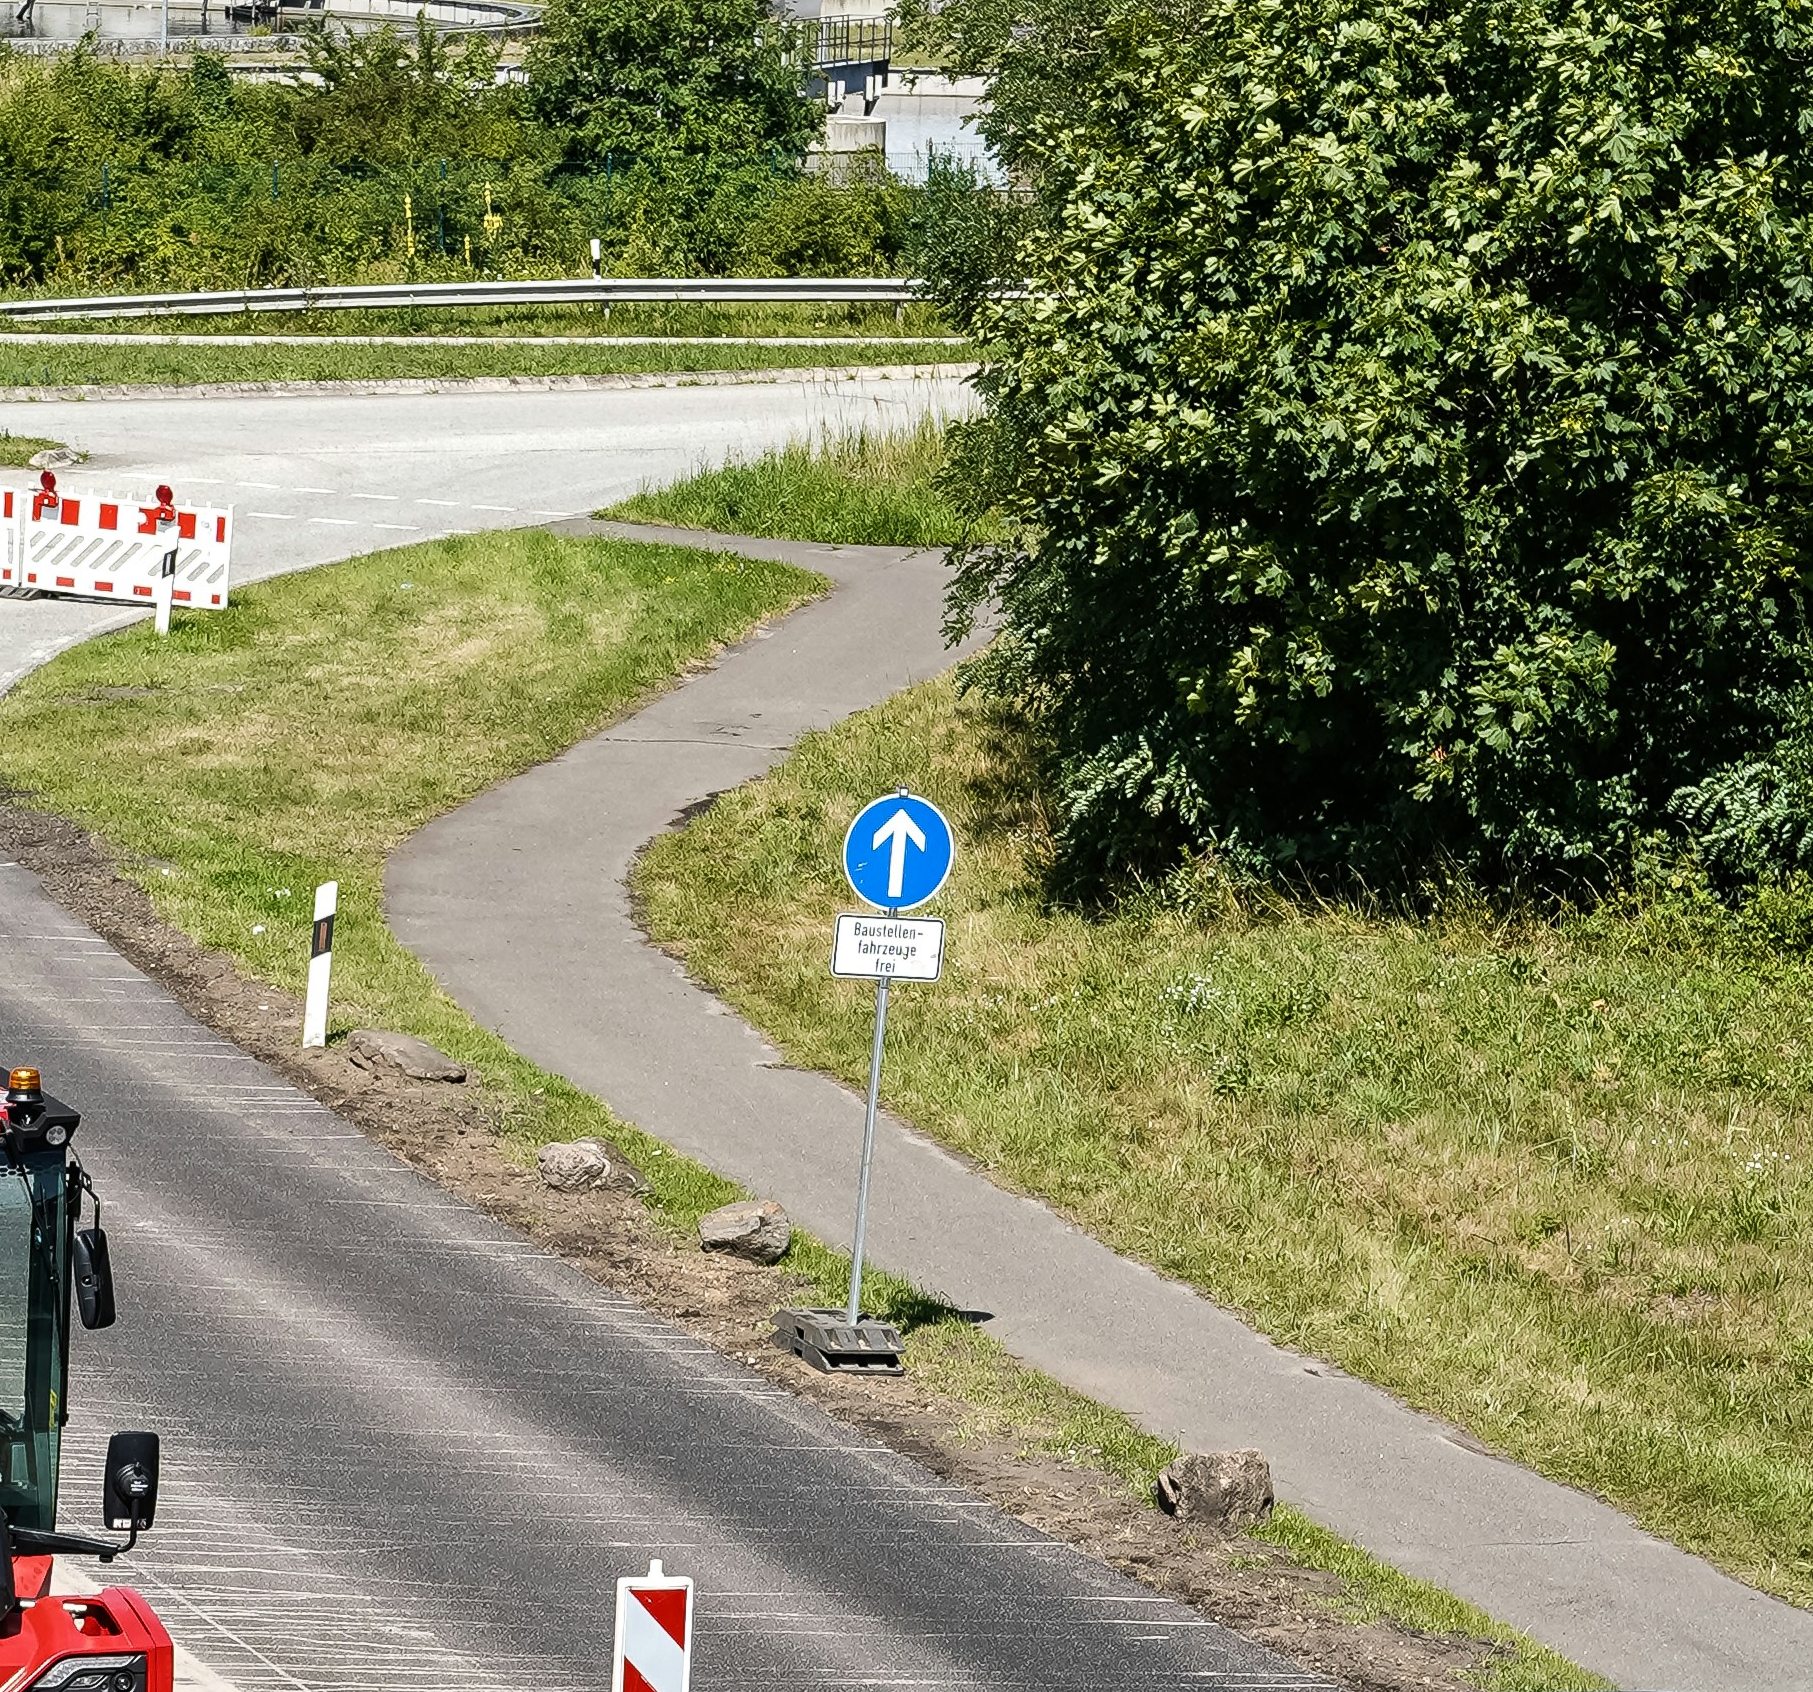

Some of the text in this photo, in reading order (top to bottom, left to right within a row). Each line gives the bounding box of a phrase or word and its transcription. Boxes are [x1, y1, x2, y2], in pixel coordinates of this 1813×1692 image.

[854, 922, 923, 939] Baustellen-
[858, 940, 916, 960] fahrzeuge
[875, 958, 895, 973] frei
